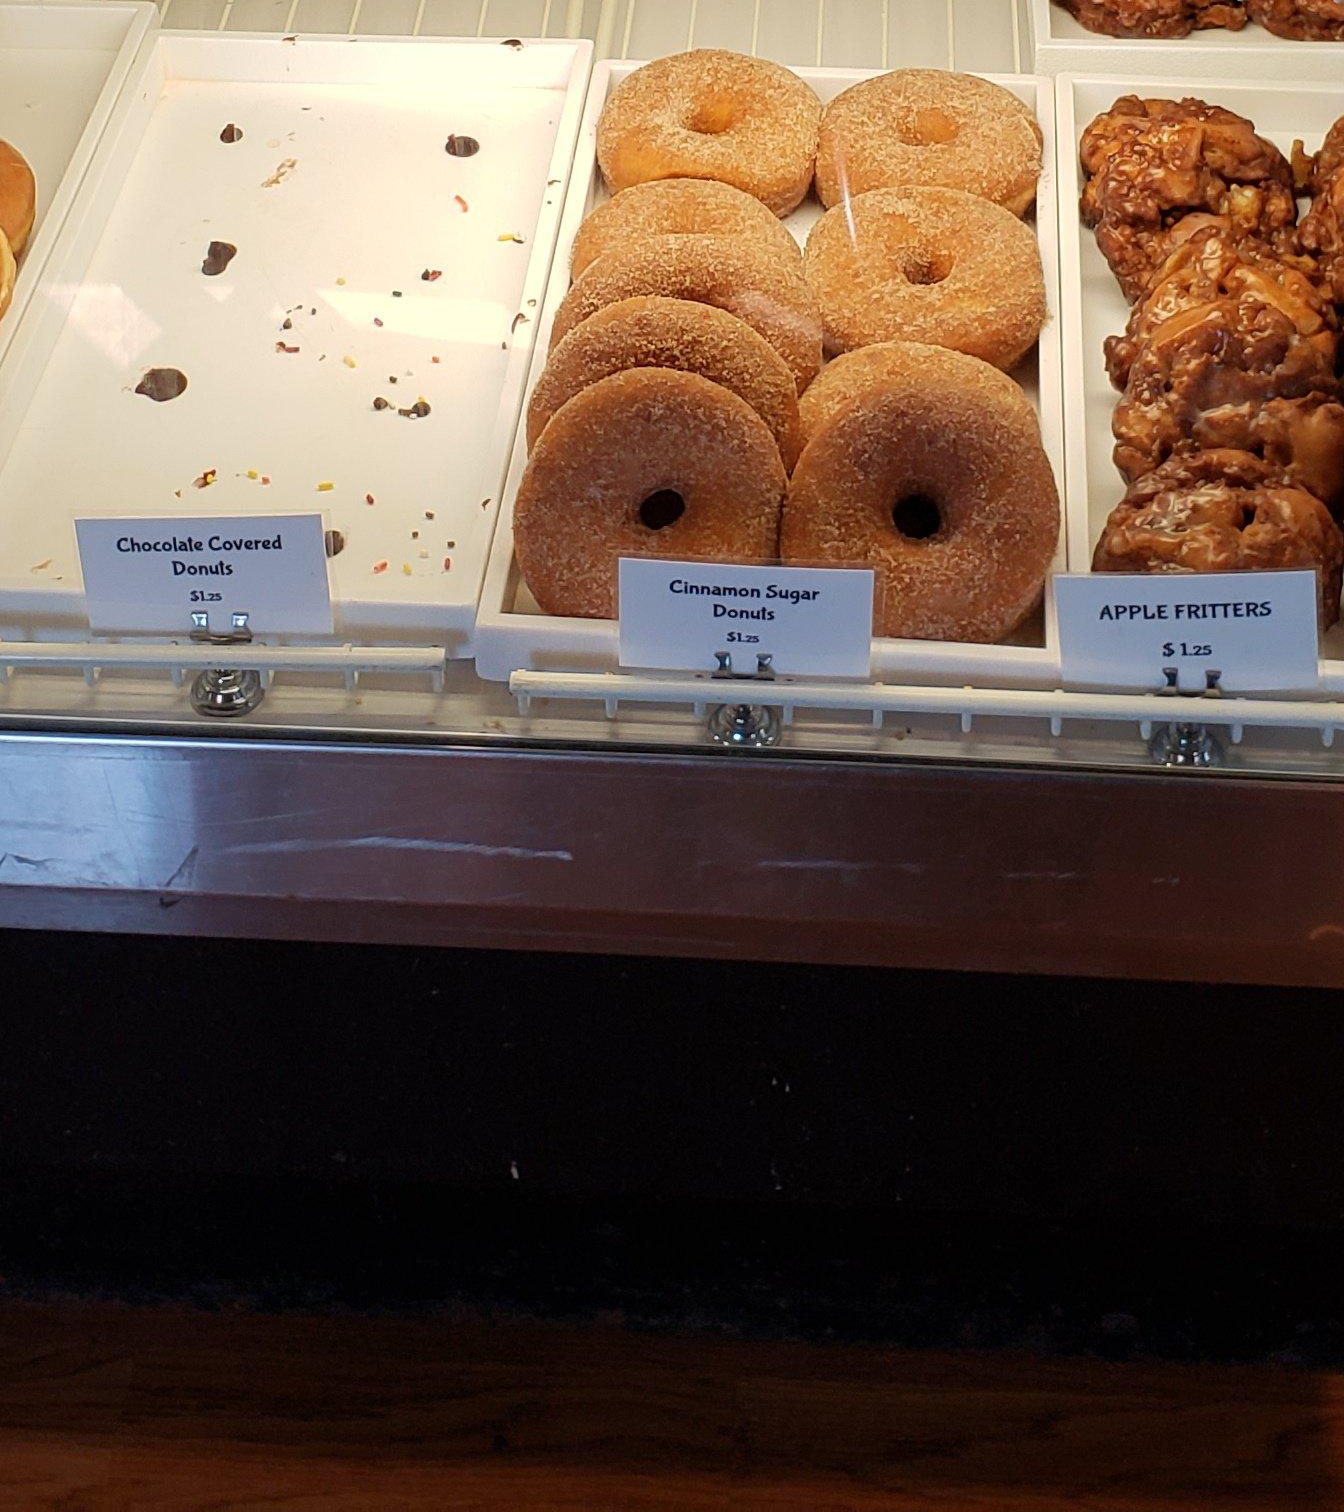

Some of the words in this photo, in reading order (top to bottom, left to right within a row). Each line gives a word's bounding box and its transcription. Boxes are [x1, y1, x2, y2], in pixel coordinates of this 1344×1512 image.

[116, 536, 204, 554] Chocolate
[208, 534, 283, 552] Covered
[171, 559, 234, 577] Donuts
[189, 589, 223, 603] $1.25
[669, 579, 761, 599] Cinnamon
[765, 584, 821, 605] Sugar
[712, 603, 776, 622] Donuts
[1098, 603, 1169, 621] APPLE
[1174, 600, 1273, 621] FRITTERS
